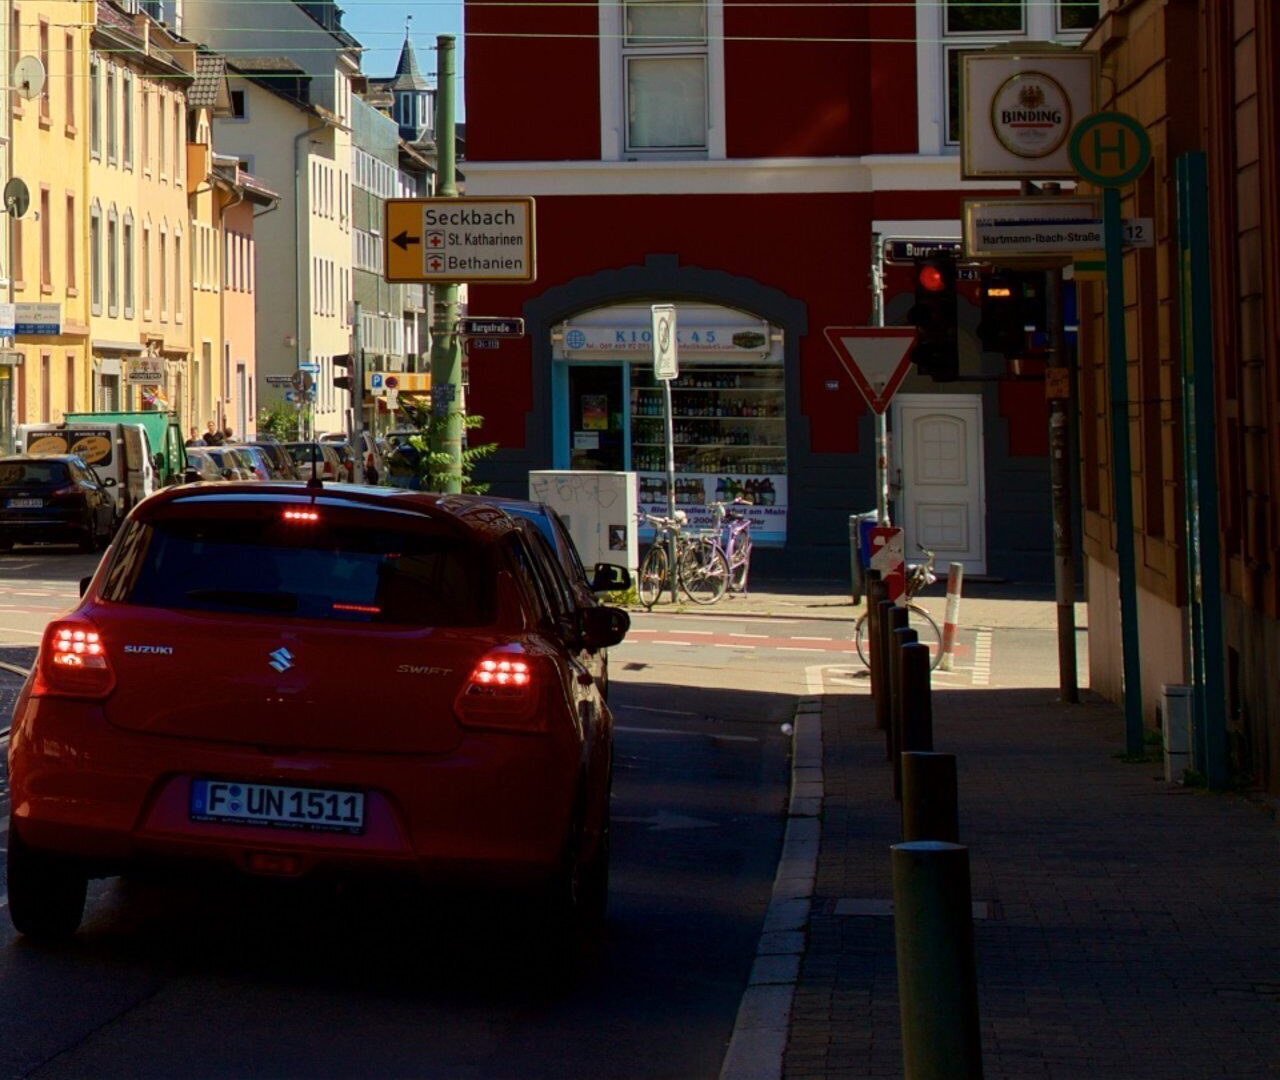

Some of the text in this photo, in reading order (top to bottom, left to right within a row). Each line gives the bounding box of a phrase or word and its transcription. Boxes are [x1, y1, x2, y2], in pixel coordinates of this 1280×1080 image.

[1002, 110, 1061, 124] BINDING
[1093, 128, 1126, 170] H
[426, 209, 515, 226] Seckbach
[983, 231, 1101, 245] Hartmann-Ibach-Straße
[1126, 225, 1144, 239] 12
[448, 233, 524, 246] St. Katharinen
[448, 256, 523, 270] Bethanien
[471, 322, 510, 333] Burgstraße
[123, 644, 173, 655] SUZUKI
[396, 664, 453, 676] SWIFT
[208, 783, 228, 811] F
[289, 791, 360, 823] 1511
